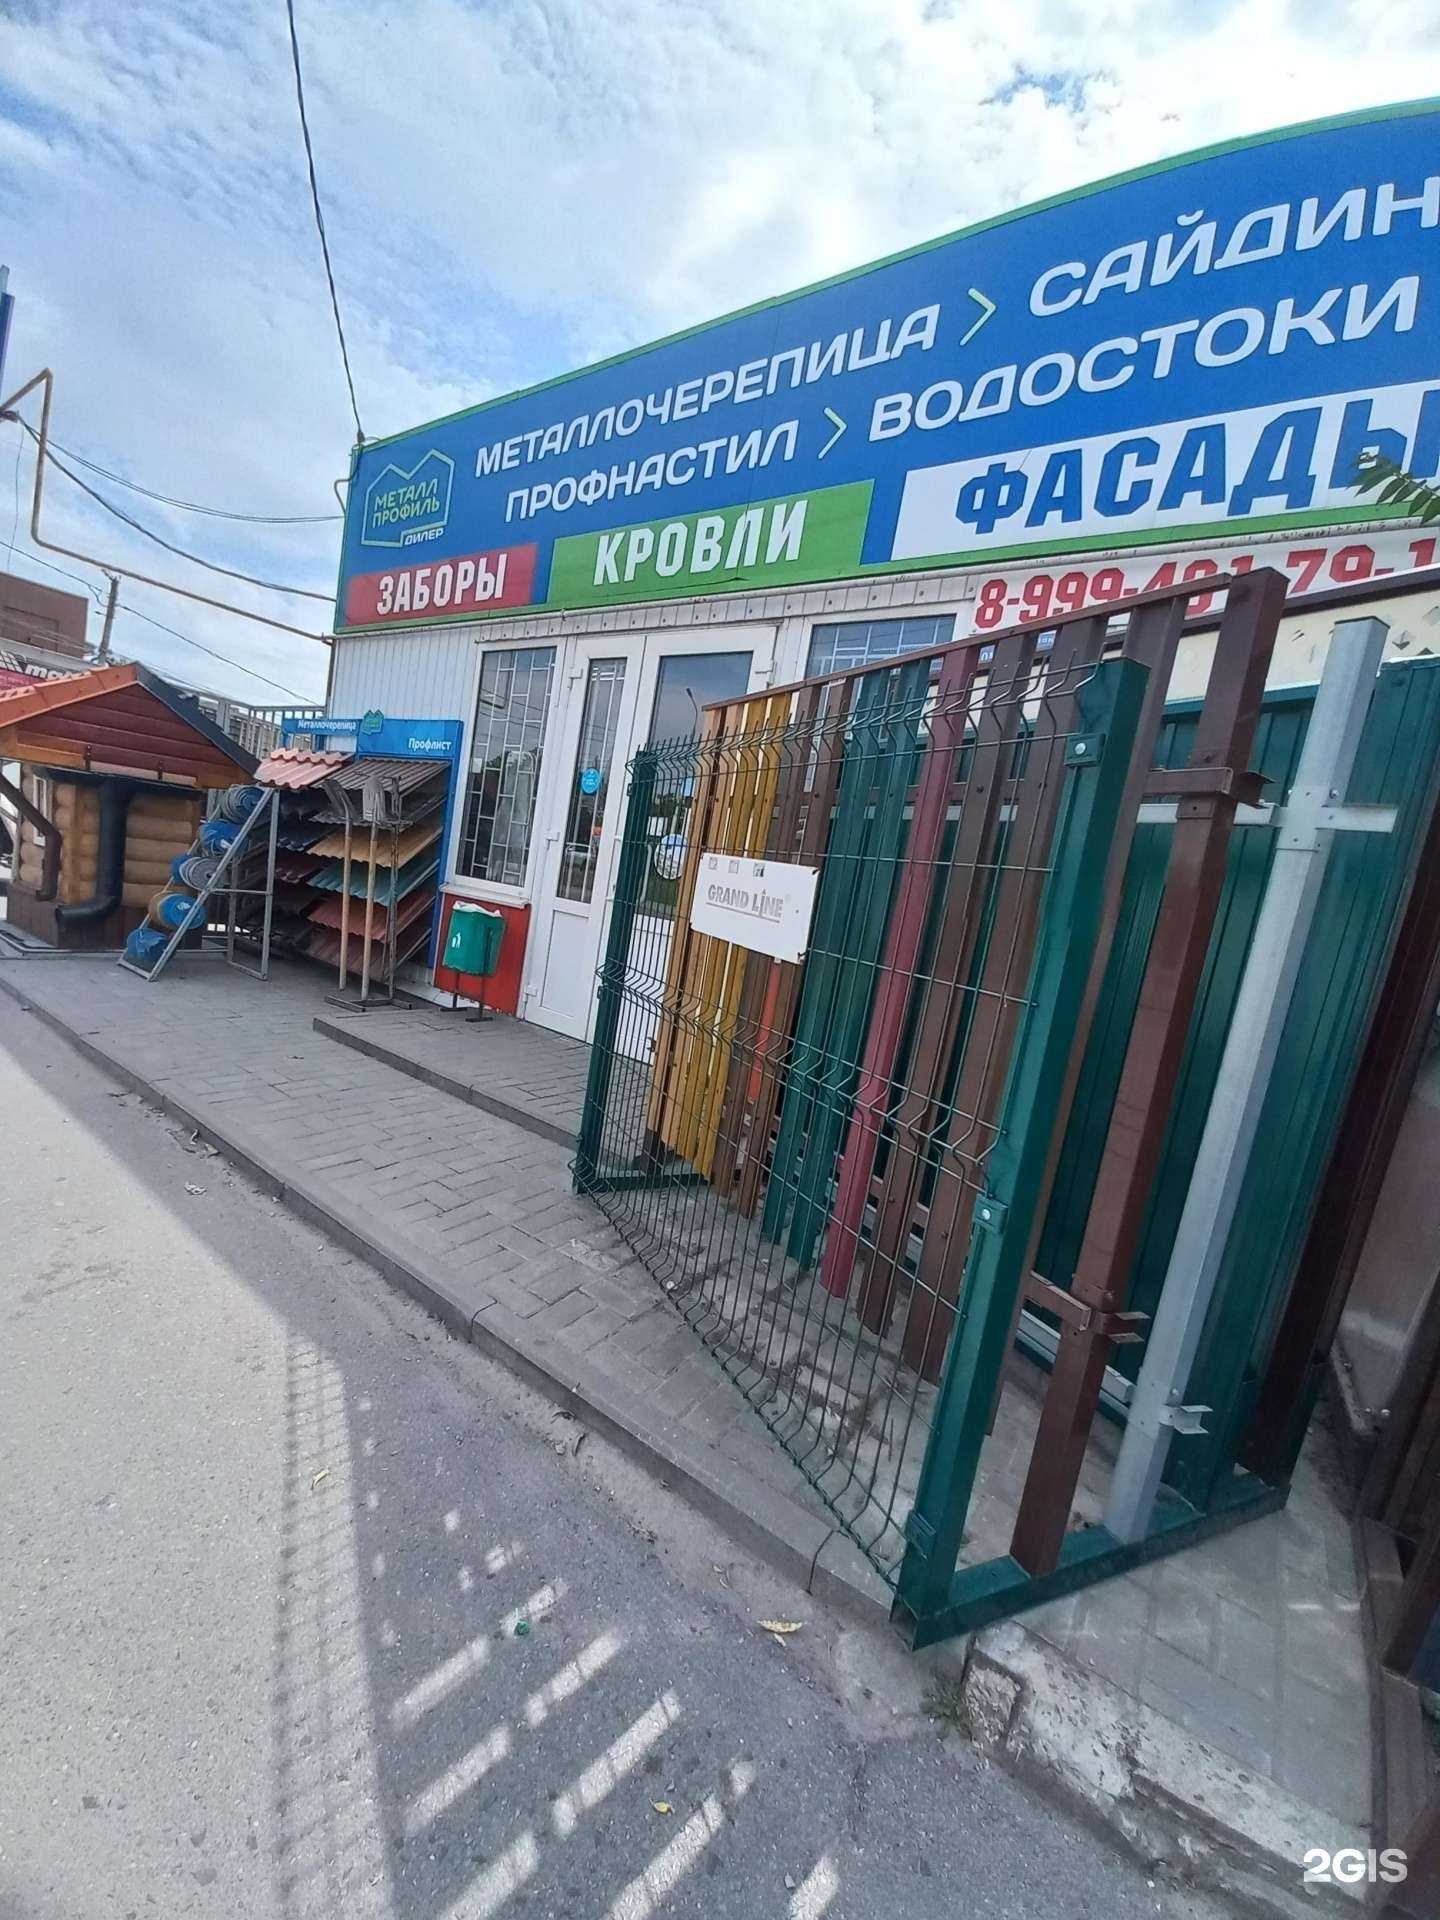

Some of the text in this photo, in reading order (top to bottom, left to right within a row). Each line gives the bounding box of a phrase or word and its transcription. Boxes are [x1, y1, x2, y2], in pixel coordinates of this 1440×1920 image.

[474, 175, 1440, 478] МЕТАЛЛОЧЕРЕПИЦА САЙДИН
[504, 275, 1420, 523] ПРОФНАСТИЛ ВОДОСТОКИ
[374, 478, 438, 511] МЕТАЛЛ
[372, 496, 440, 528] ПРОФИЛЬ
[404, 527, 444, 546] ДИЛЕР
[593, 500, 808, 586] КРОВЛИ
[376, 553, 508, 616] ЗАБОРЫ
[408, 737, 452, 751] Профлист
[708, 884, 749, 910] GRAND
